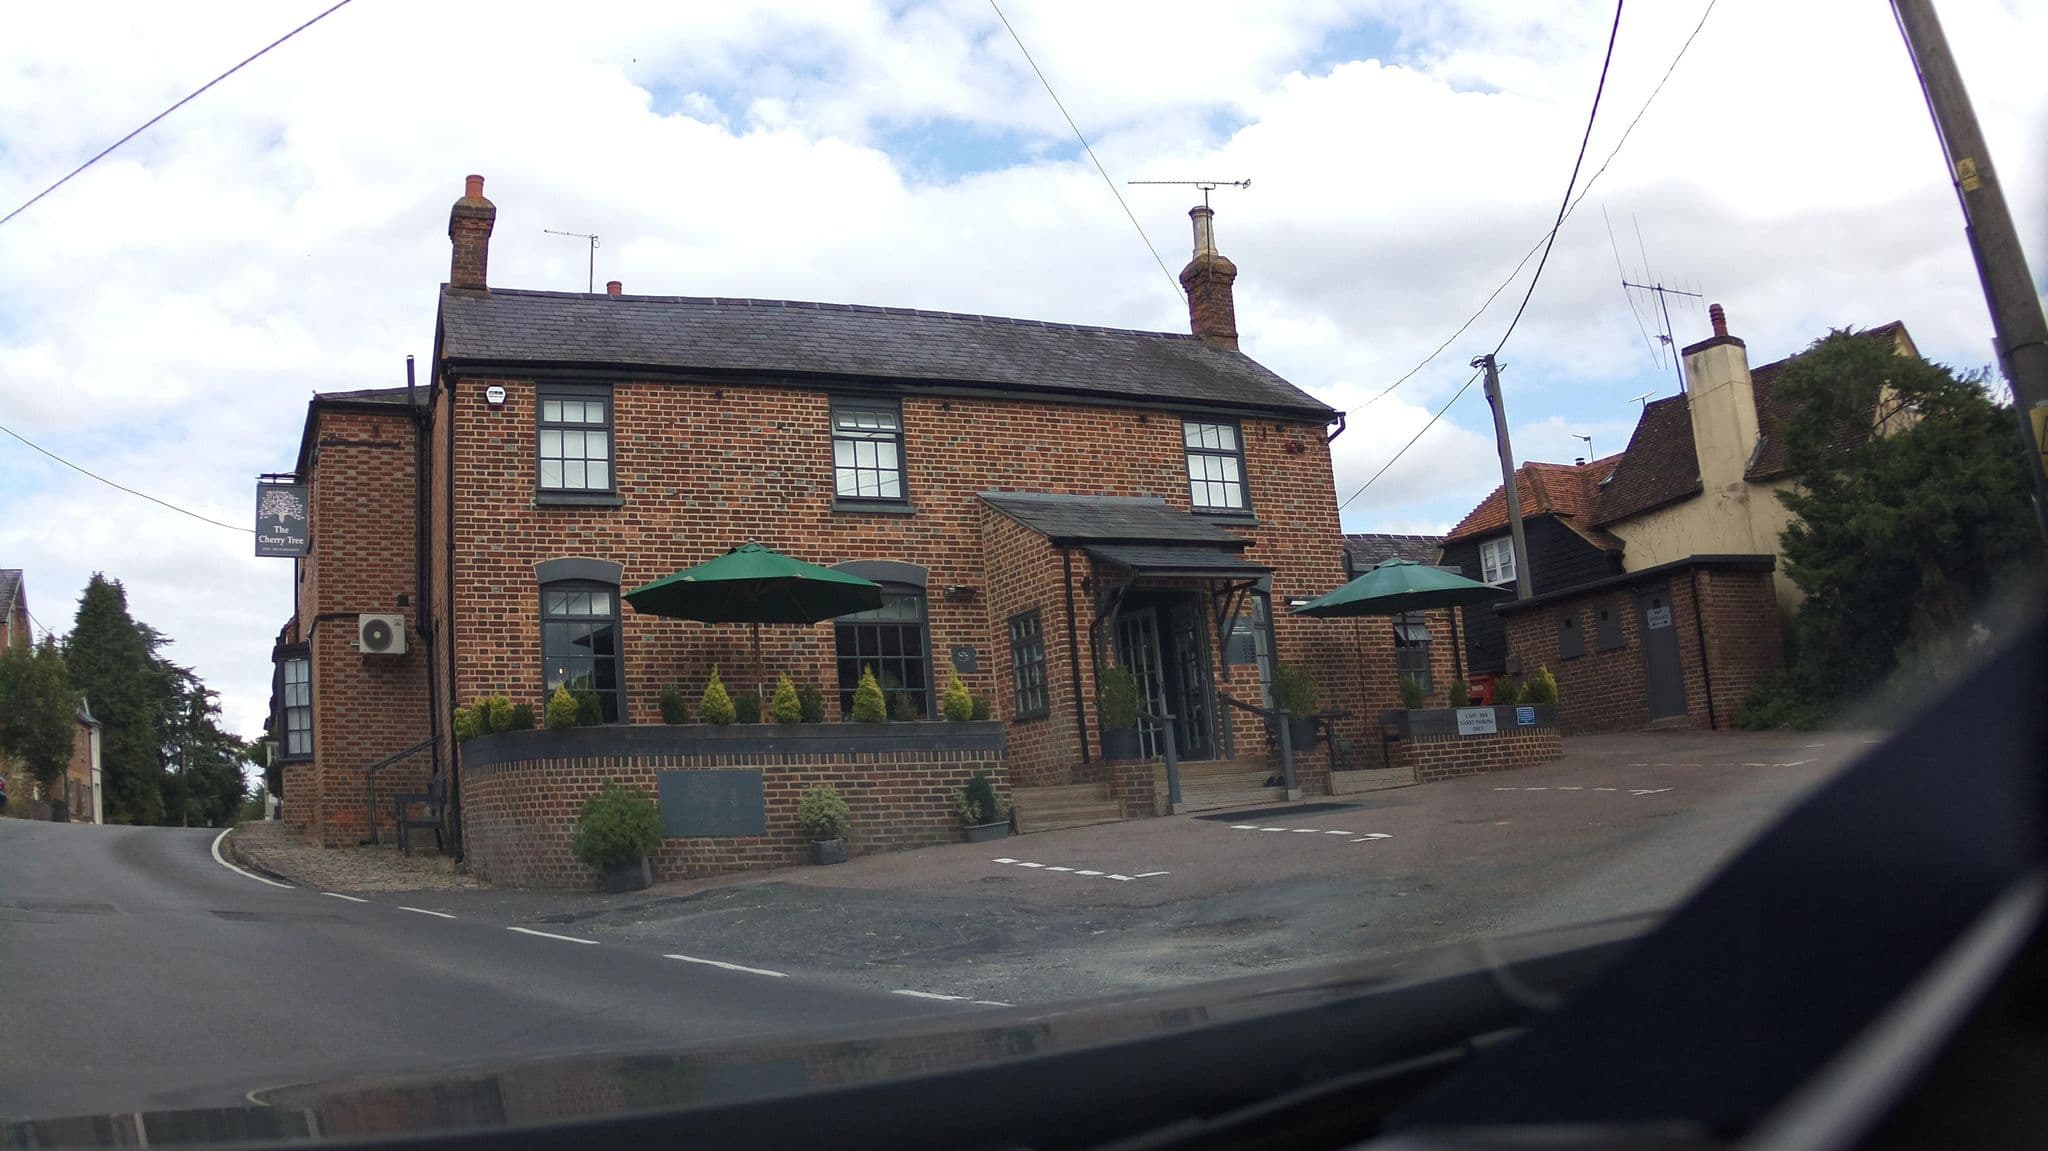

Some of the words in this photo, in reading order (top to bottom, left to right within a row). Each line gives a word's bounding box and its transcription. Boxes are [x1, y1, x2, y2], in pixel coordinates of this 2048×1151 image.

[273, 525, 290, 534] The
[258, 534, 286, 546] Cherry
[287, 536, 304, 545] Tree
